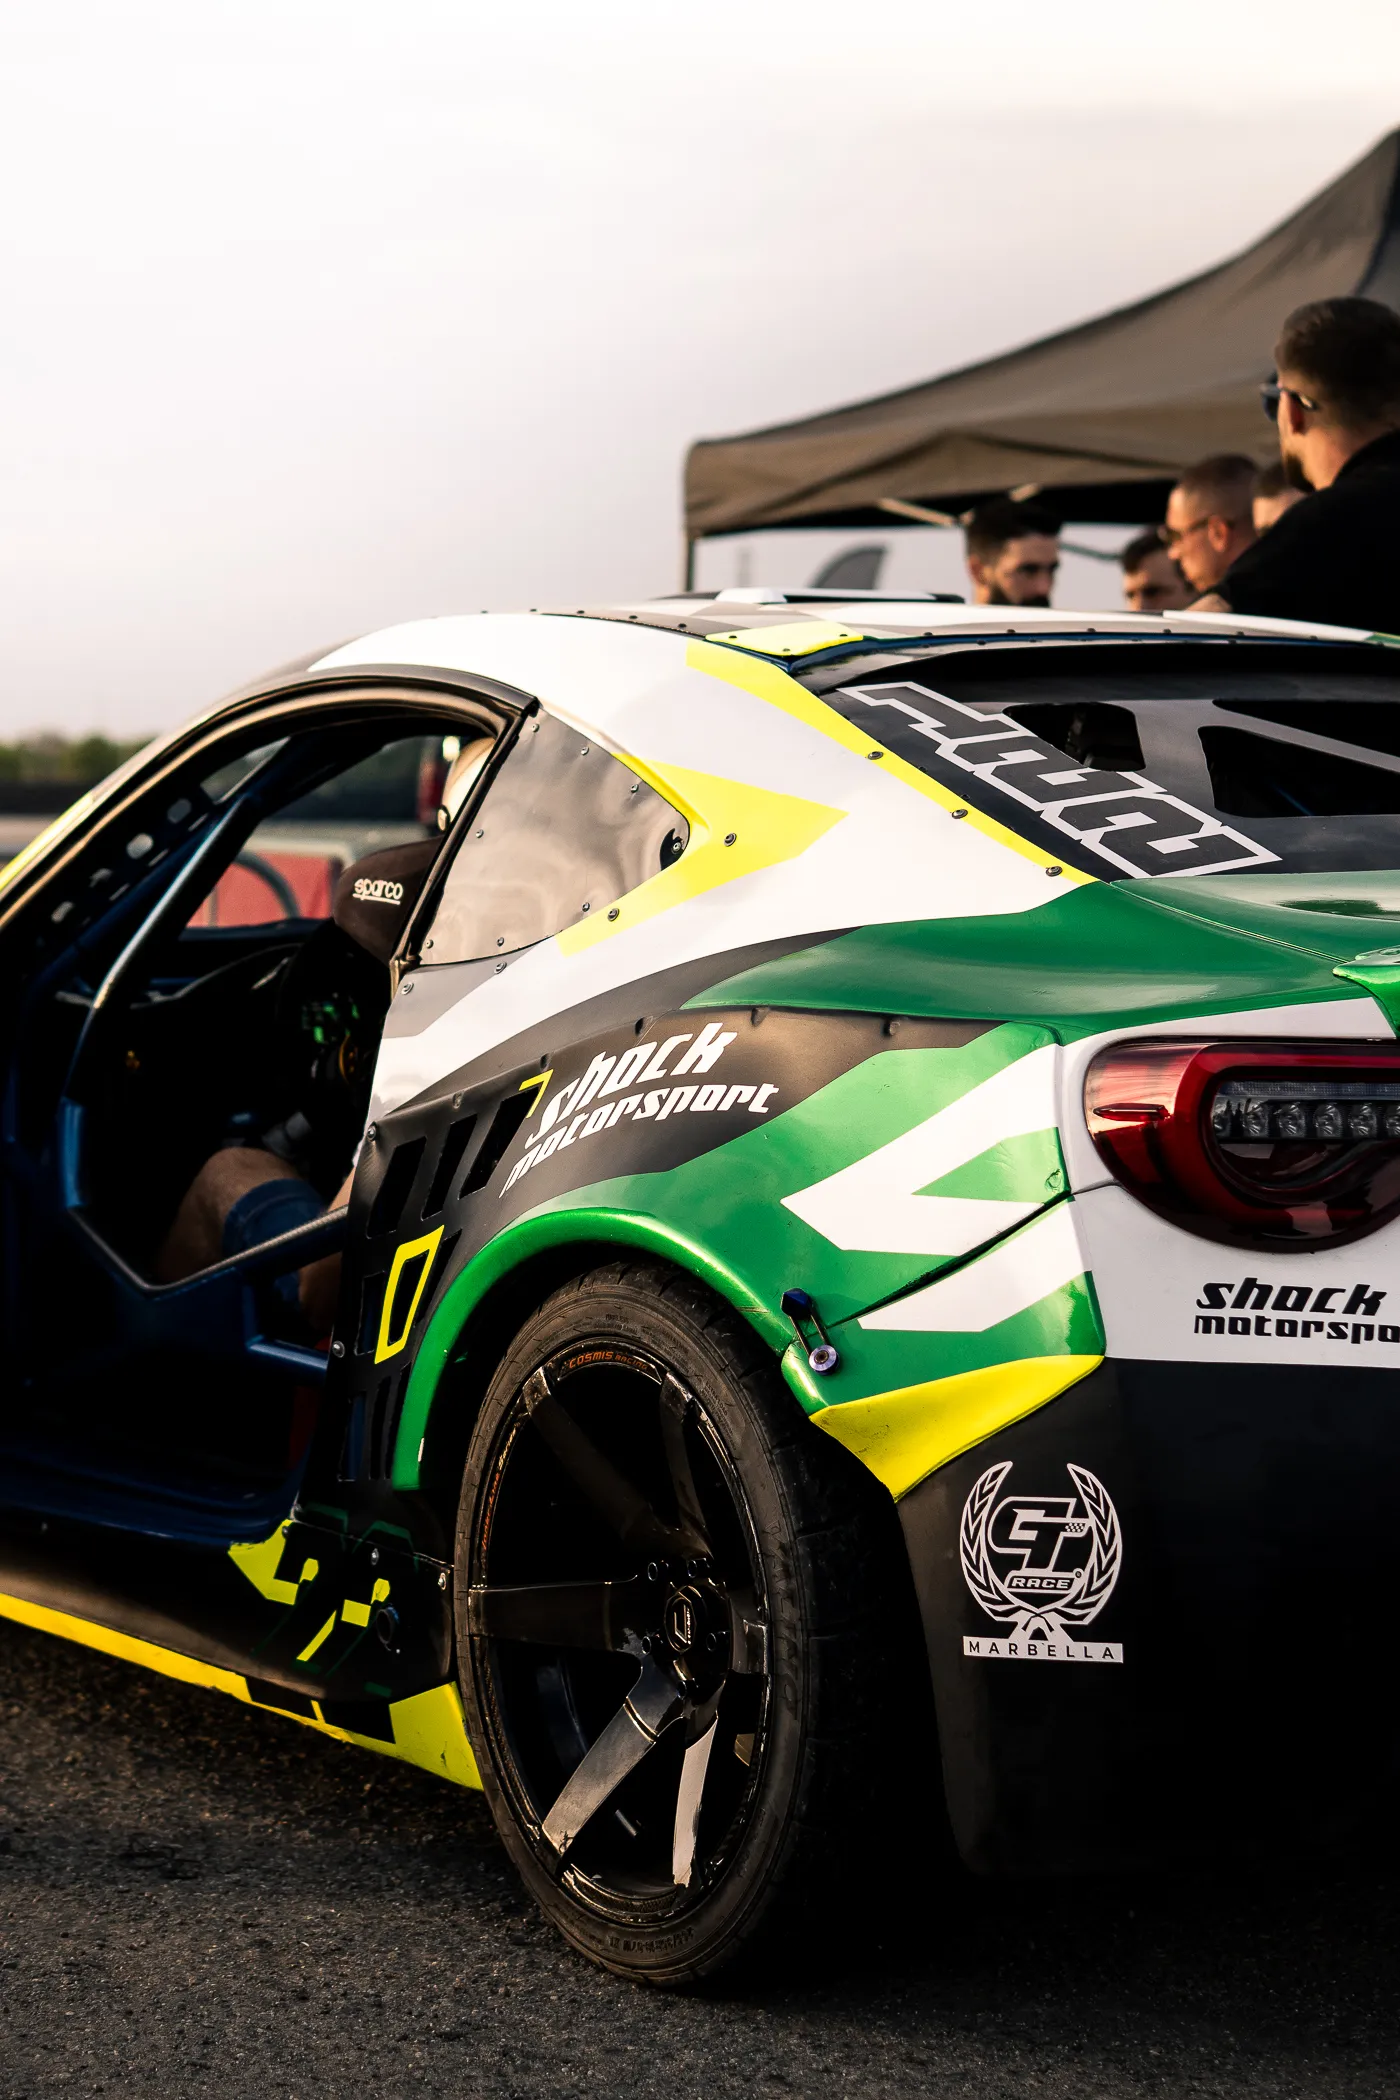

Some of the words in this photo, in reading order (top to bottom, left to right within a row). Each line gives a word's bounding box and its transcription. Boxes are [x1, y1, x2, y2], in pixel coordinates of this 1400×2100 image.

[354, 878, 404, 901] sparco
[525, 1022, 738, 1150] shock
[498, 1082, 780, 1199] motorsport
[1196, 1277, 1388, 1316] shock
[569, 1351, 614, 1369] COSMIS
[987, 1496, 1092, 1572] GT
[1011, 1577, 1071, 1589] RACE
[969, 1640, 1115, 1660] MARBELLA
